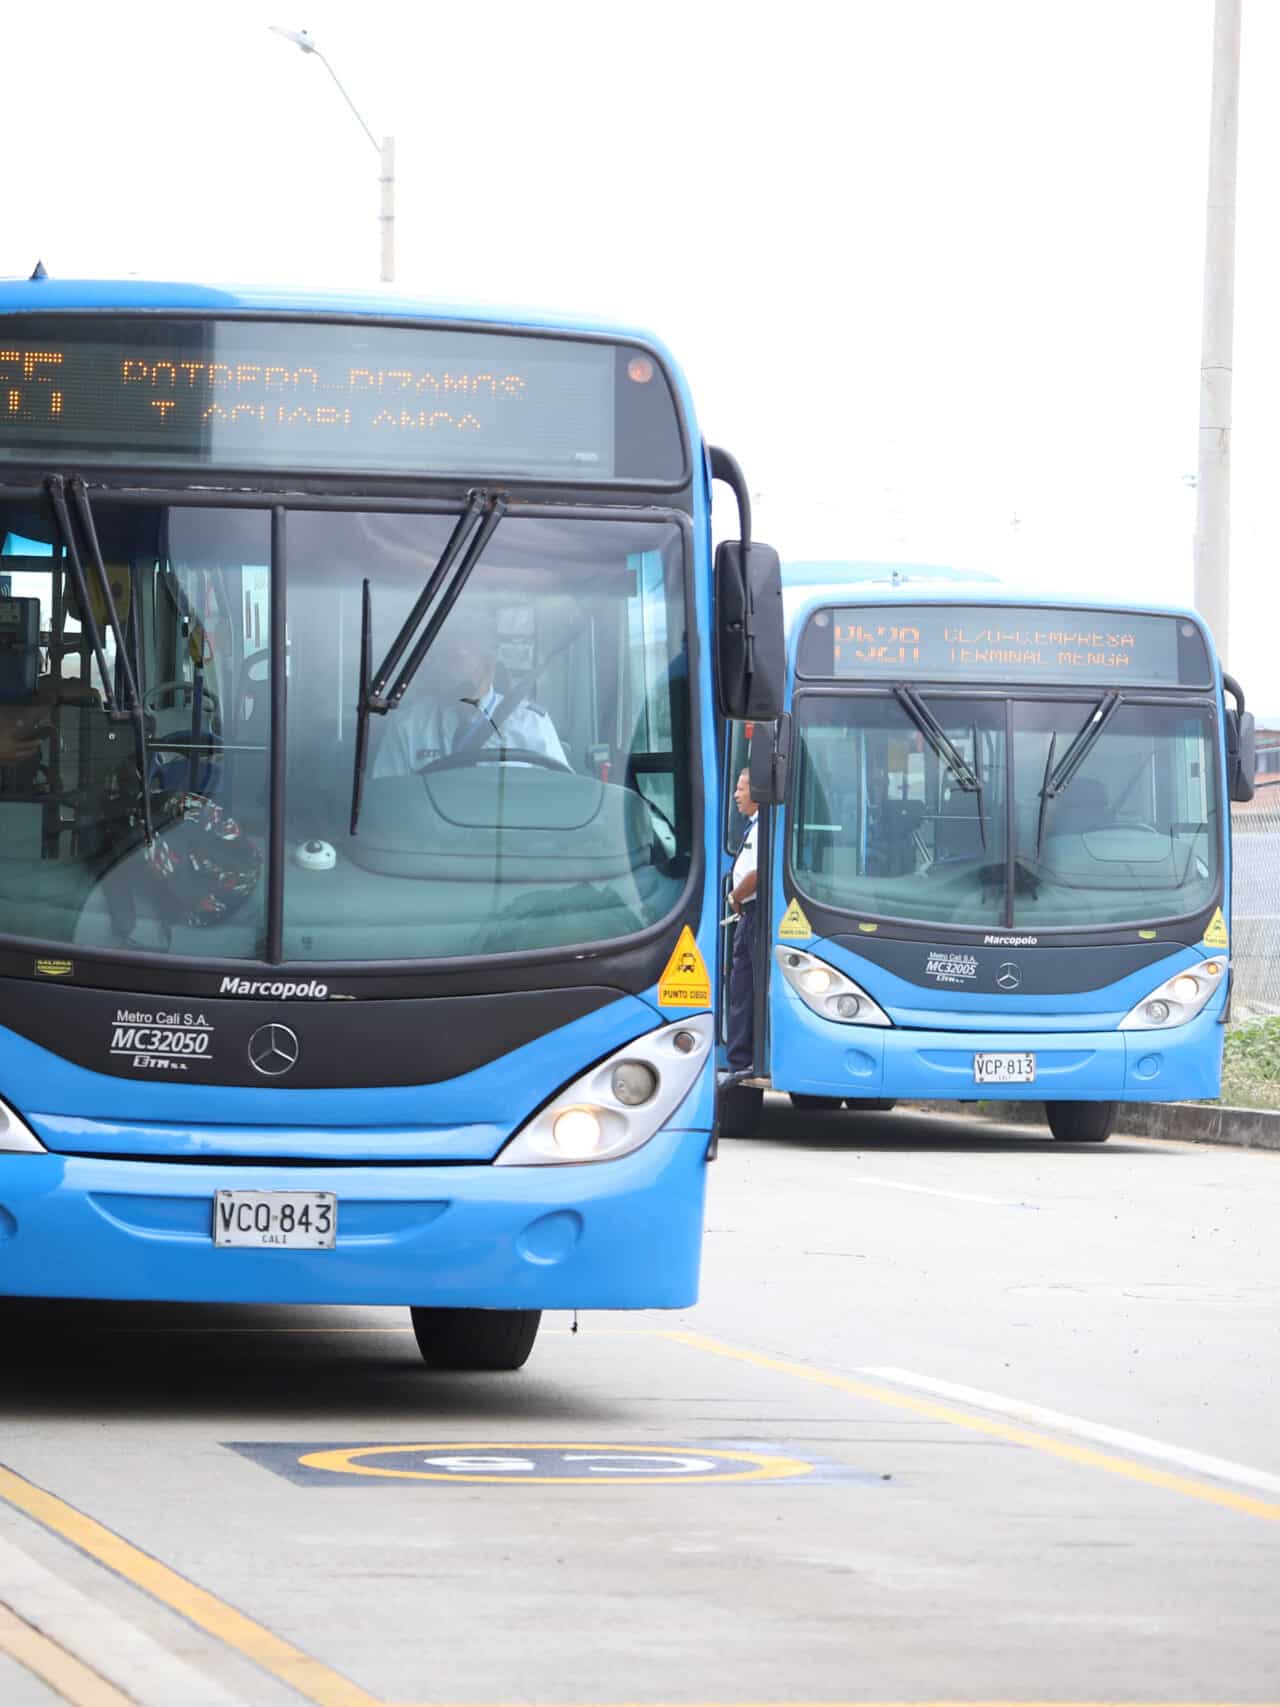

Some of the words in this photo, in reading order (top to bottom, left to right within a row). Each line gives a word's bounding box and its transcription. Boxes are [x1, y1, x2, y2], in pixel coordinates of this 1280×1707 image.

[984, 935, 1038, 946] Marcopolo
[925, 960, 977, 975] MC32005
[220, 977, 328, 999] Marcopolo
[663, 989, 688, 999] PUNTO
[116, 1009, 153, 1023] Metro
[156, 1012, 180, 1025] Cali
[183, 1013, 210, 1026] S.A.
[111, 1028, 209, 1053] MC32050
[262, 1234, 288, 1244] CALI
